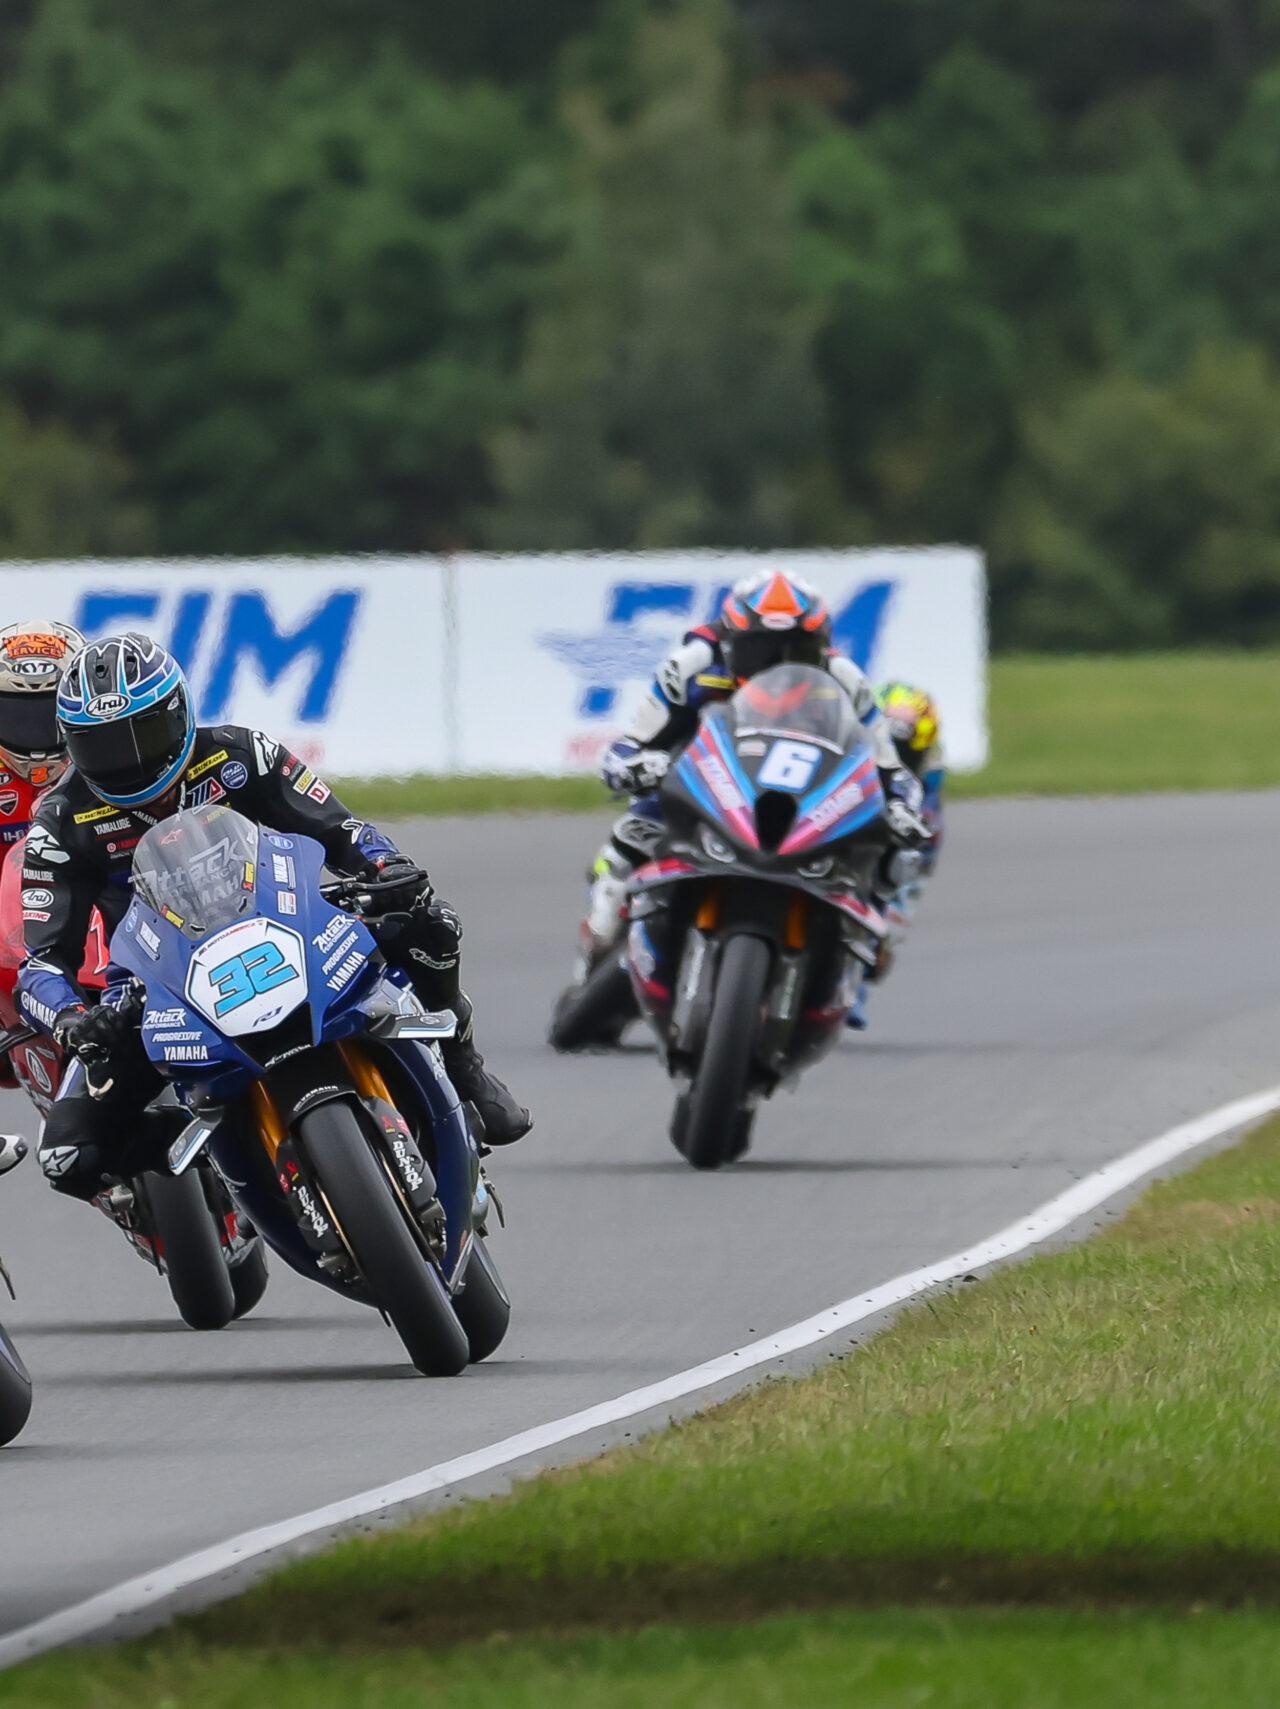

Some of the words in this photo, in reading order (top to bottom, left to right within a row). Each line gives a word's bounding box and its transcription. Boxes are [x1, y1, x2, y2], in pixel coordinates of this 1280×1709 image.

[4, 633, 67, 648] WATSON
[8, 646, 65, 659] SERVICES
[89, 696, 124, 713] Arai
[193, 753, 225, 775] DUNLOP
[758, 739, 821, 790] 6
[93, 818, 132, 836] YAMALUBE
[312, 914, 356, 950] Attack
[207, 941, 300, 1019] 32
[326, 951, 366, 991] YAMAHA
[29, 997, 58, 1029] YAMAH
[144, 1008, 187, 1026] Attack
[163, 1045, 208, 1061] YAMAHA
[392, 1140, 424, 1192] DUNLOP
